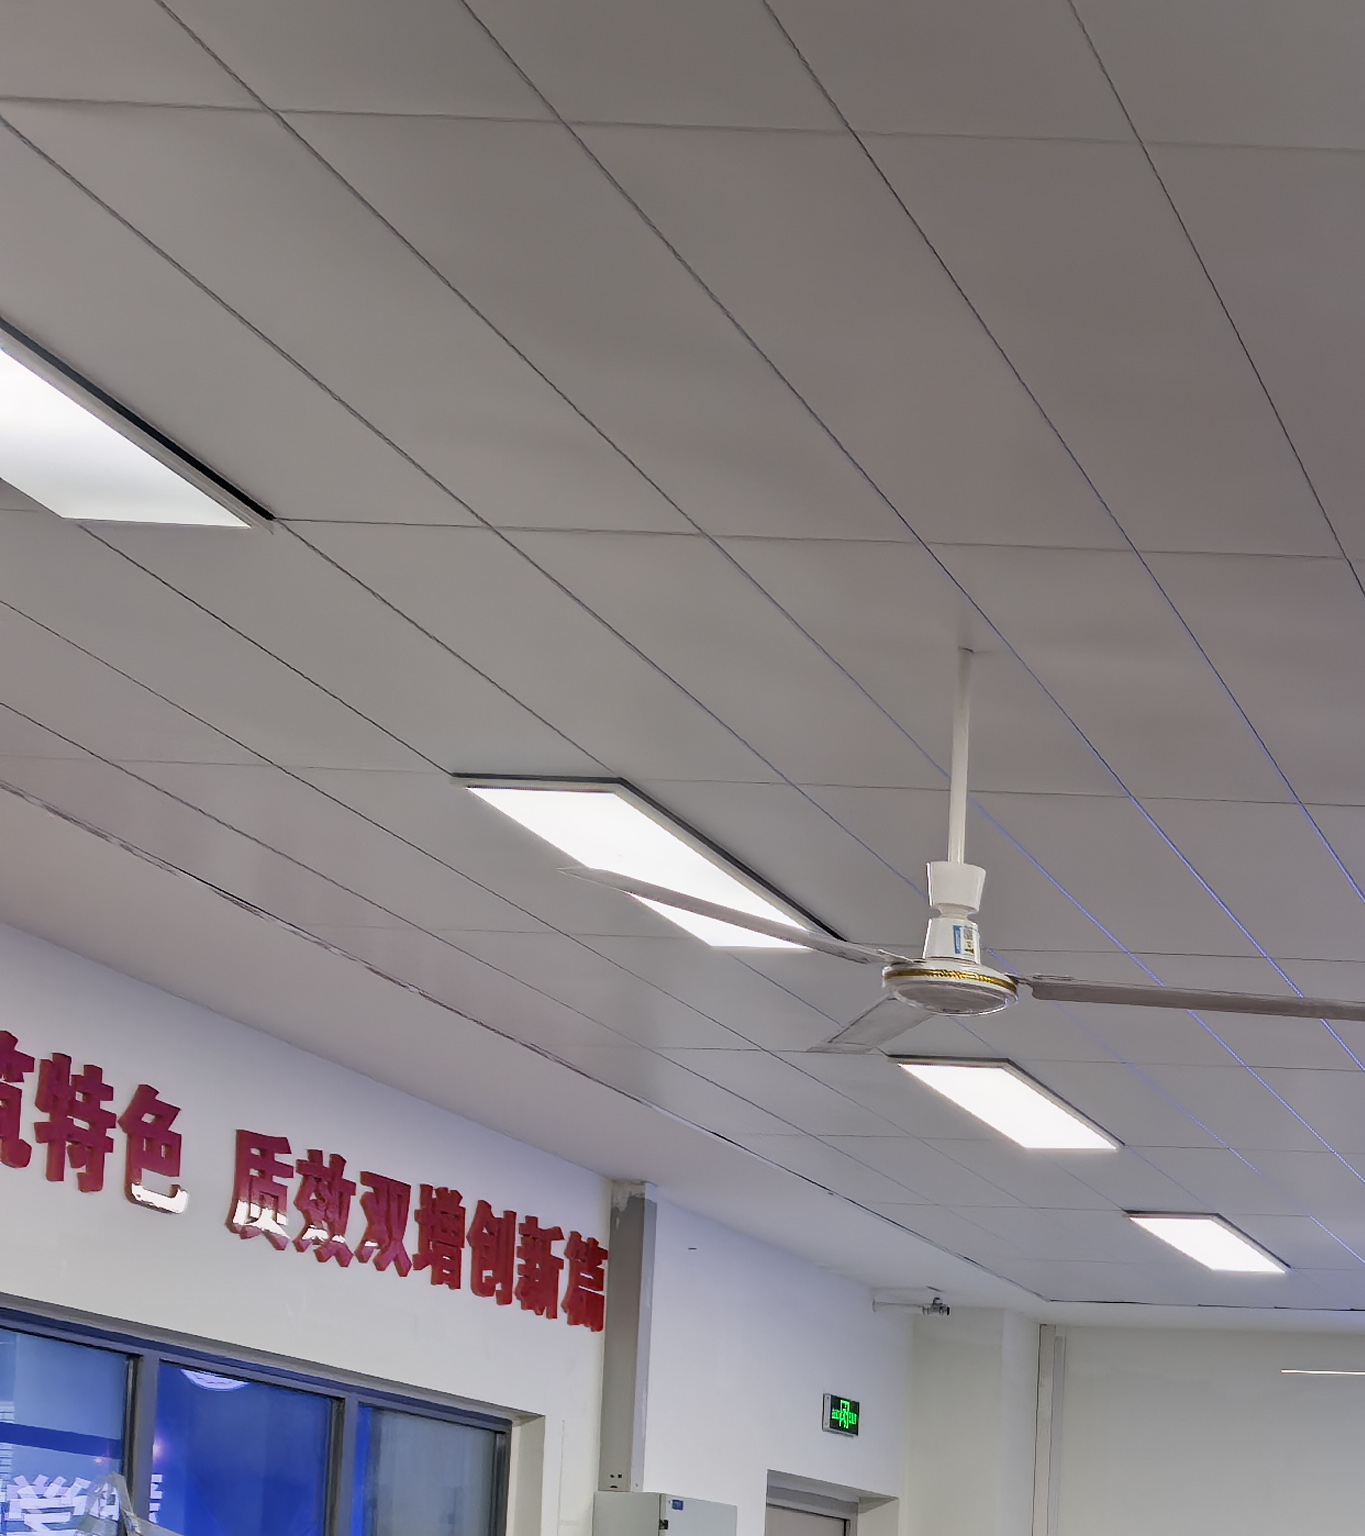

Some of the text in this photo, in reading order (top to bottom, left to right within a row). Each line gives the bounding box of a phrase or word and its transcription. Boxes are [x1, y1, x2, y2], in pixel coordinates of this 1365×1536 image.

[226, 1129, 609, 1332] 质效双增创新篇
